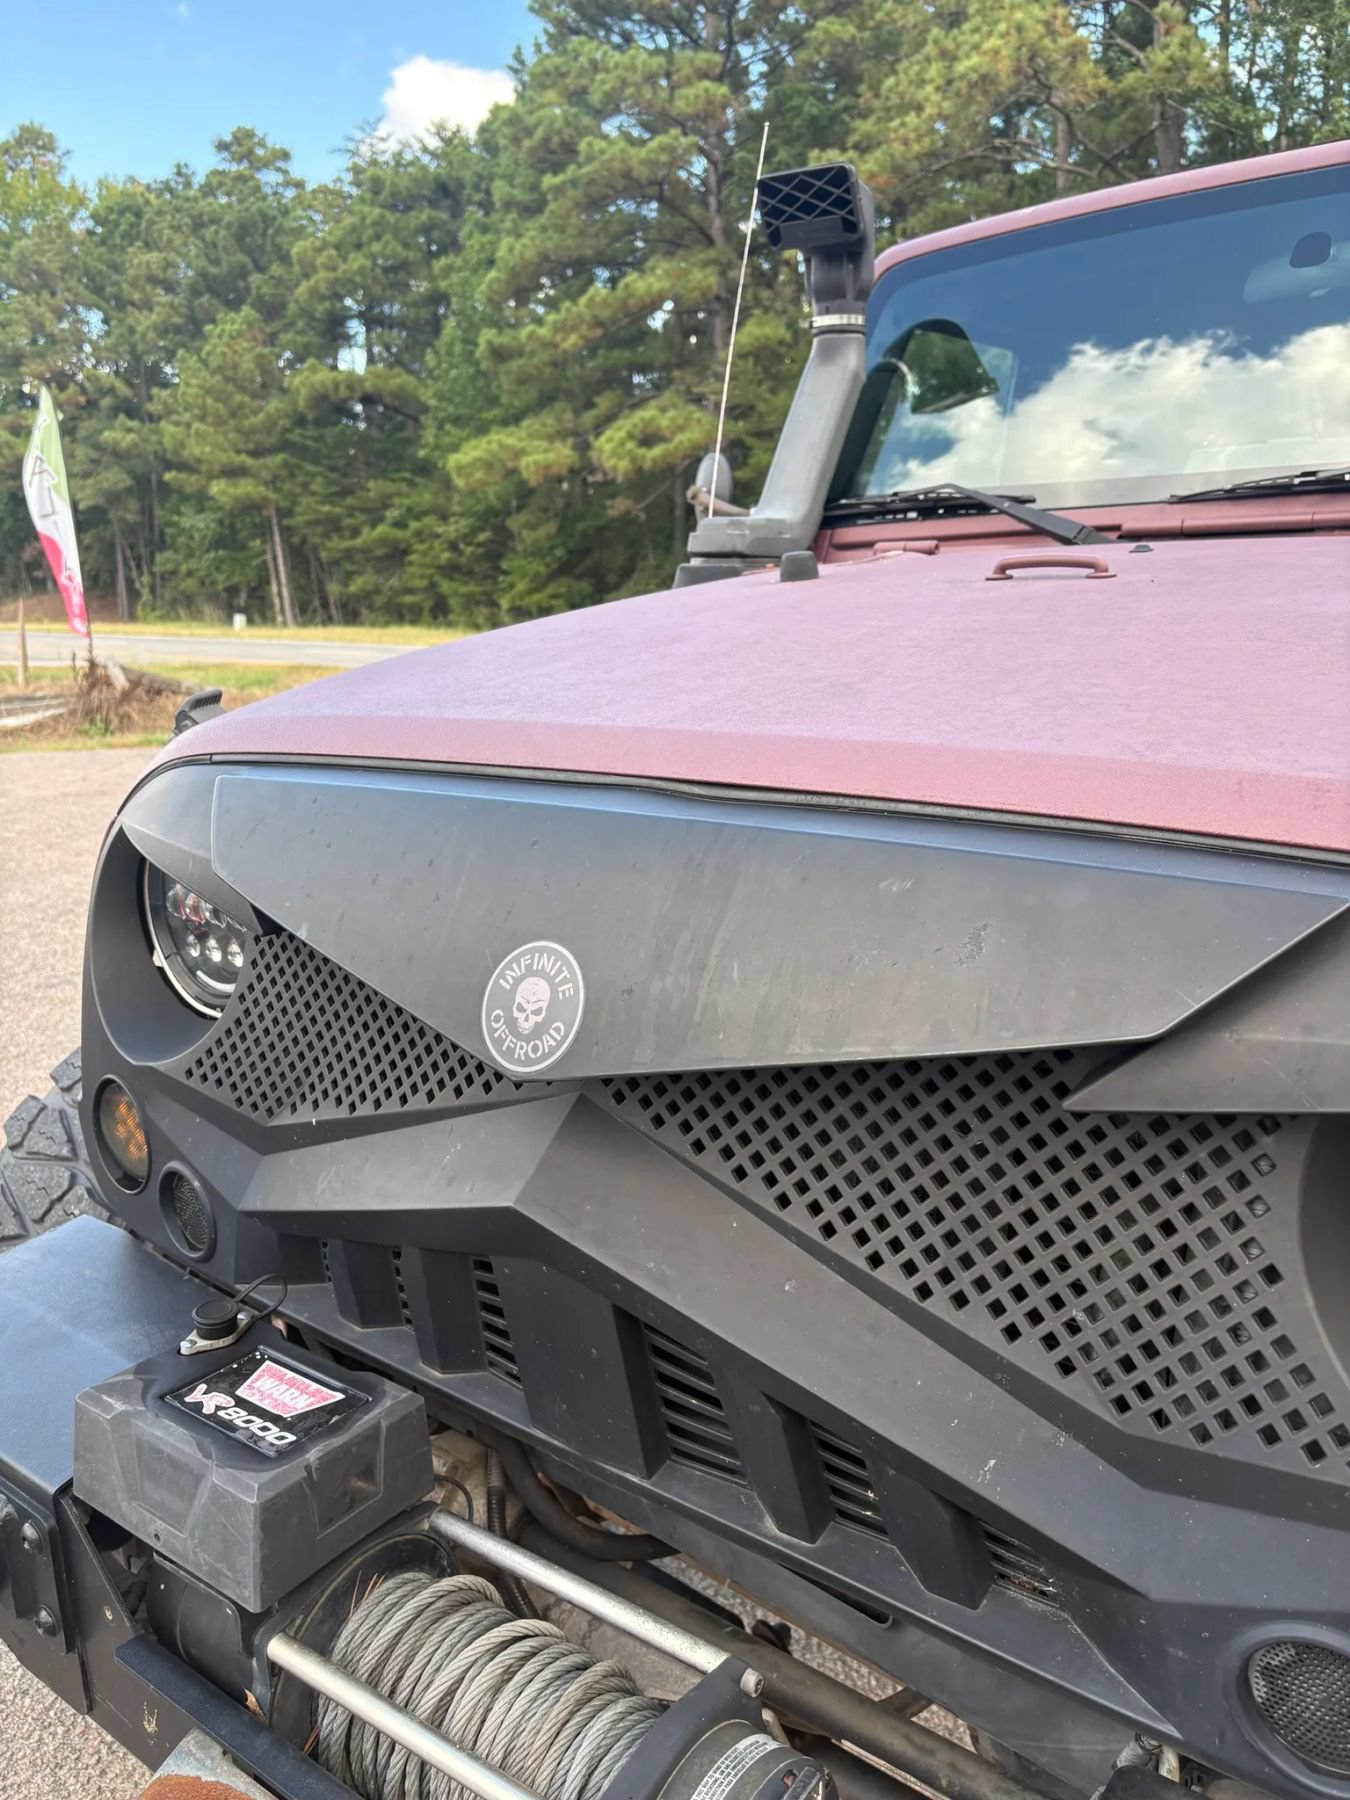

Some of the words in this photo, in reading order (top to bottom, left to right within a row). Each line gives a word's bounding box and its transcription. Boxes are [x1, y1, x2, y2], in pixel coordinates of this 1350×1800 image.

[499, 952, 574, 1000] INFINITE
[491, 1009, 565, 1060] OFFROAD
[253, 1375, 315, 1408] WARN
